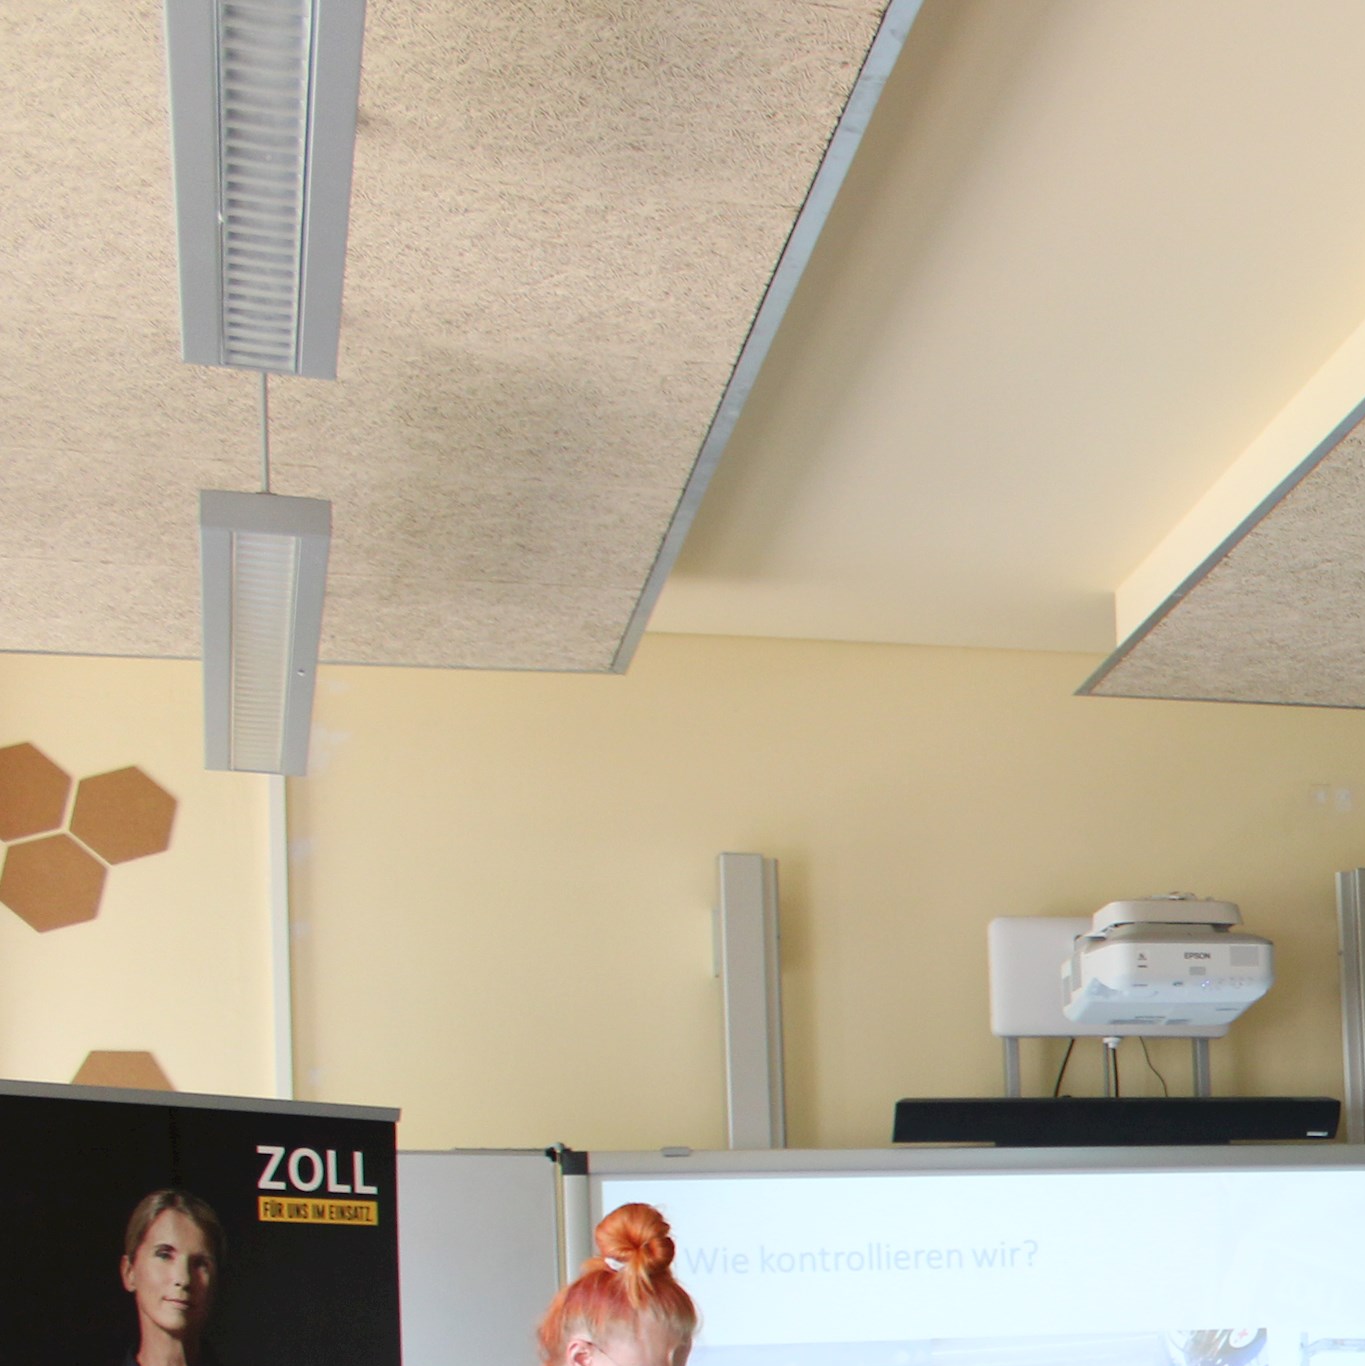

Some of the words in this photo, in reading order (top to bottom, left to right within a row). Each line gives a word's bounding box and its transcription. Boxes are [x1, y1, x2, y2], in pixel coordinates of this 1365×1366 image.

[256, 1145, 378, 1195] ZOLL
[263, 1200, 284, 1218] FÜR
[287, 1203, 309, 1219] UNS
[685, 1247, 749, 1274] Wie
[759, 1241, 962, 1274] kontrollieren
[972, 1240, 1038, 1268] wir?
